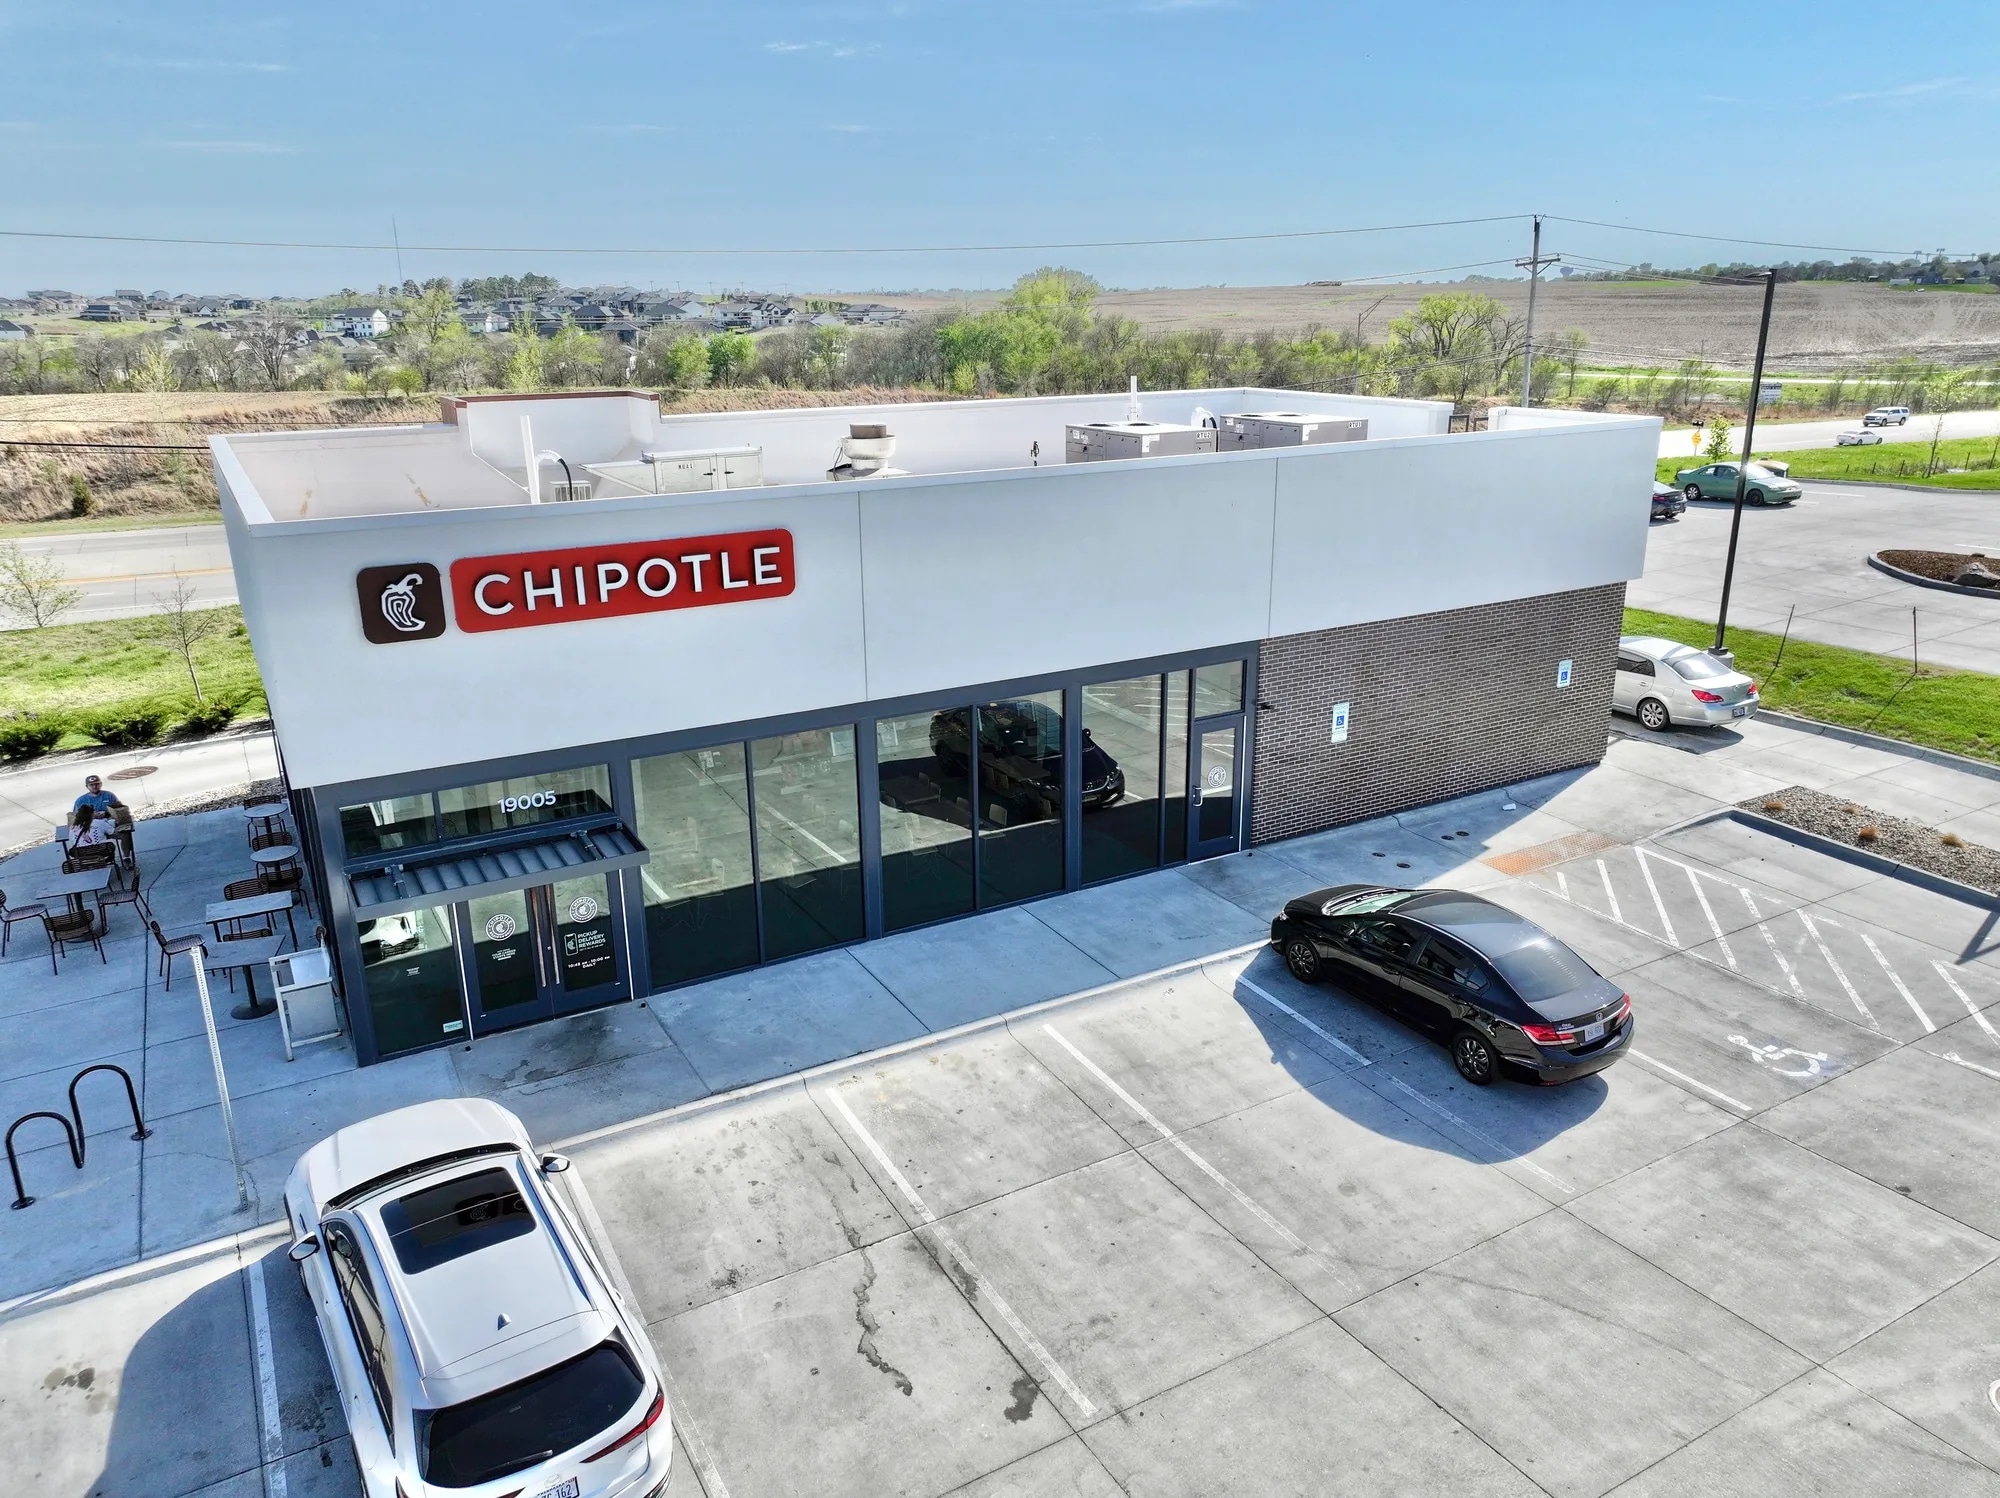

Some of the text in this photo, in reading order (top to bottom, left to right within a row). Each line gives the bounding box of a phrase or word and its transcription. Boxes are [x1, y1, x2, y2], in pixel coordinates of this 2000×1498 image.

[474, 546, 782, 616] CHIPOTLE
[497, 790, 556, 813] 19005
[577, 930, 598, 938] PICKUP
[578, 933, 605, 943] DELIVERY
[578, 938, 606, 948] REWARDS
